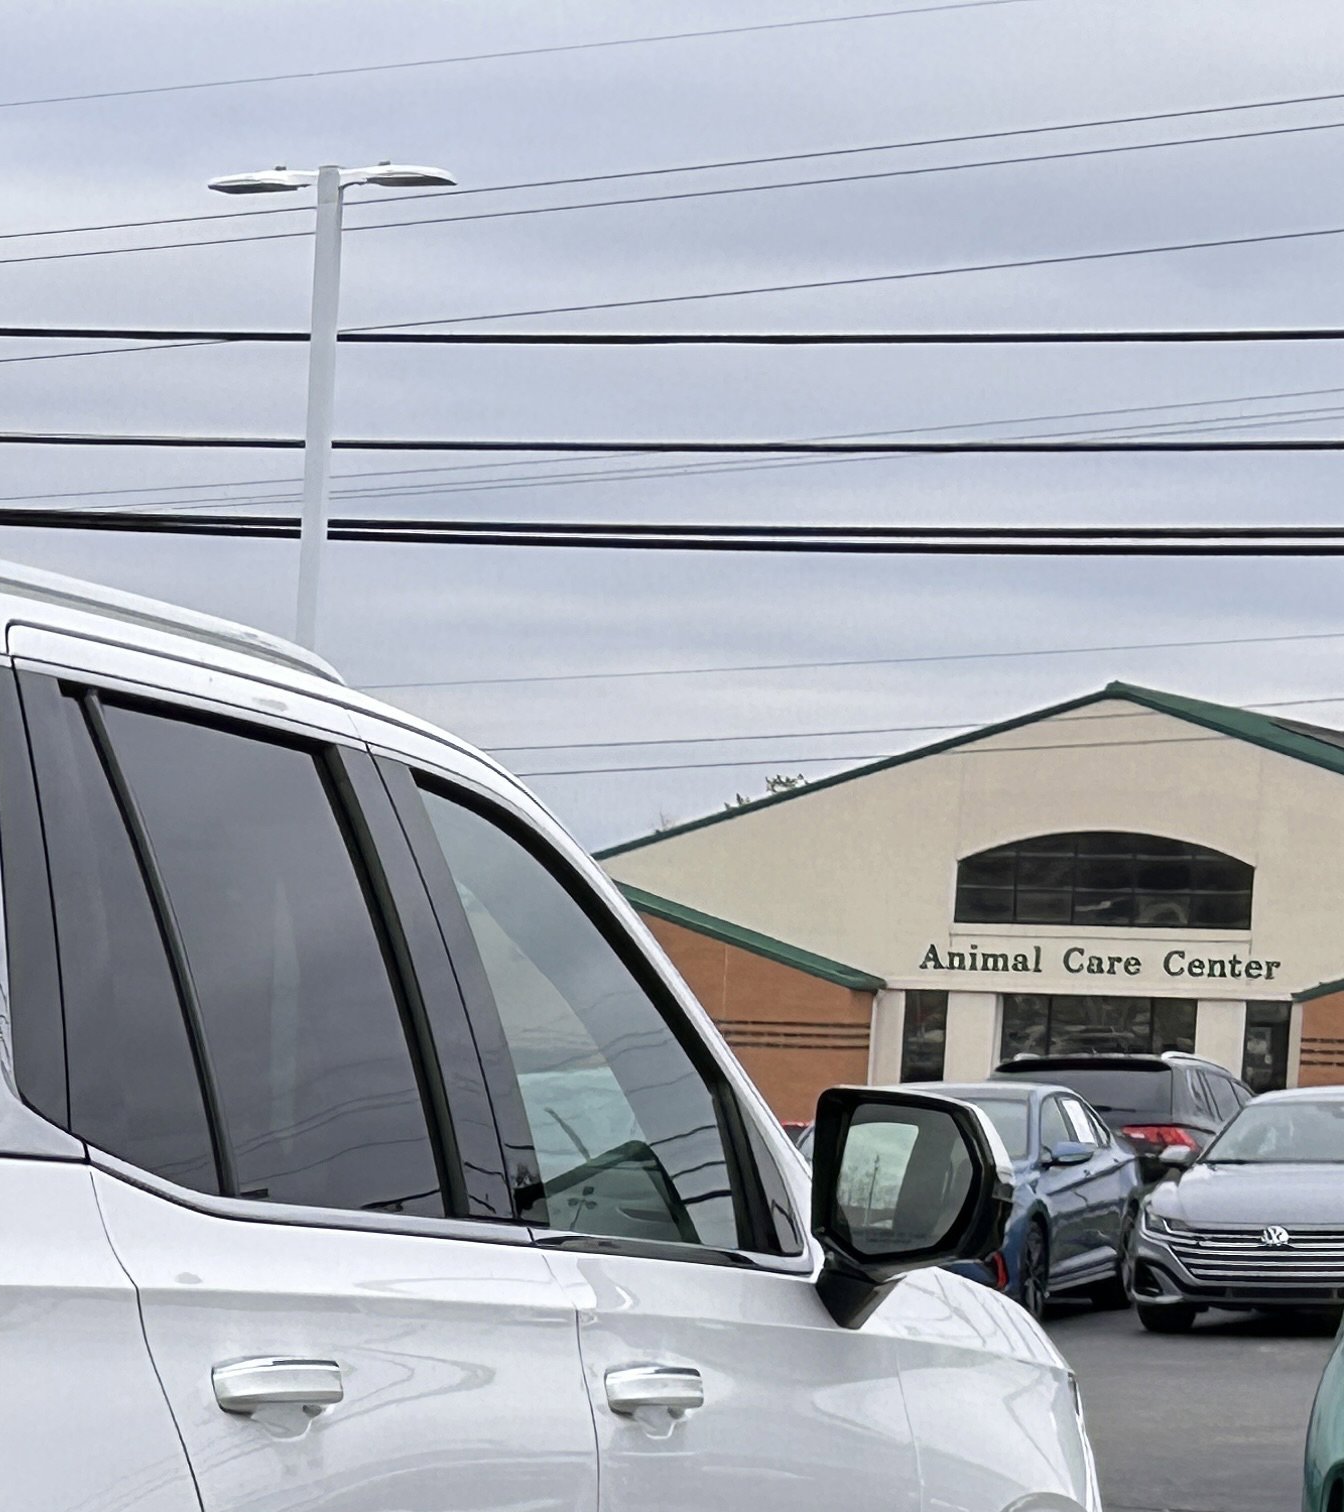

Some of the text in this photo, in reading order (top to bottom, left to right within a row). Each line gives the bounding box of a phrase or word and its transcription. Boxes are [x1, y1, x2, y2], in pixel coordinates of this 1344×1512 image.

[918, 943, 1282, 980] Animal Care Center
